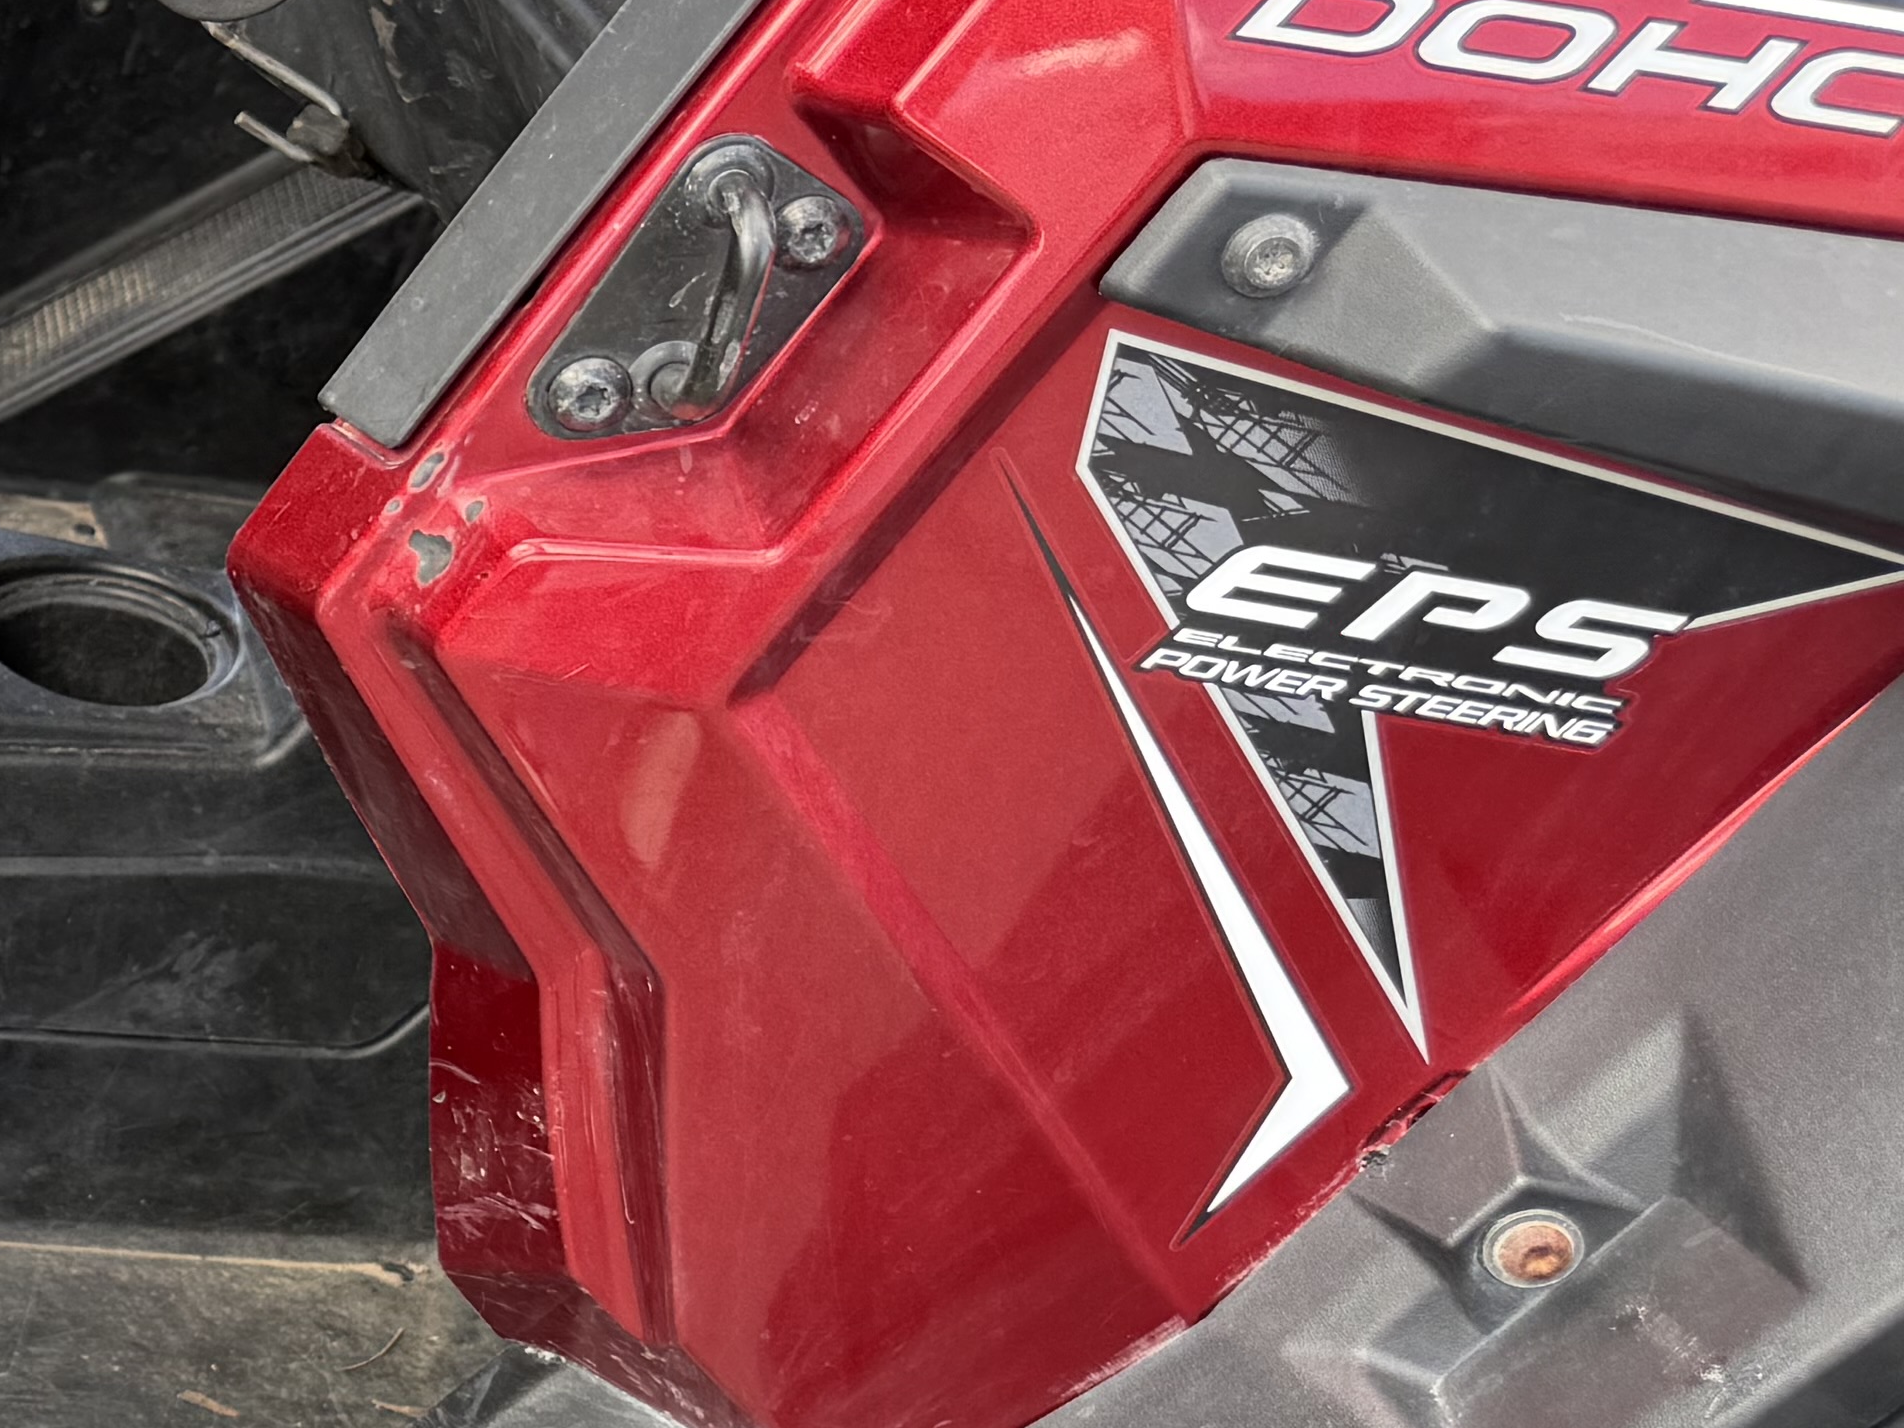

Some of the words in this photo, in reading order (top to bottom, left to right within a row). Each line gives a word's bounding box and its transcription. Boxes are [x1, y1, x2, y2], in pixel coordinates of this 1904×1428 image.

[1186, 545, 1688, 679] EPS
[1141, 647, 1348, 702] POWER
[1349, 682, 1615, 747] STEERING
[1173, 628, 1624, 715] ELECTRONIC
